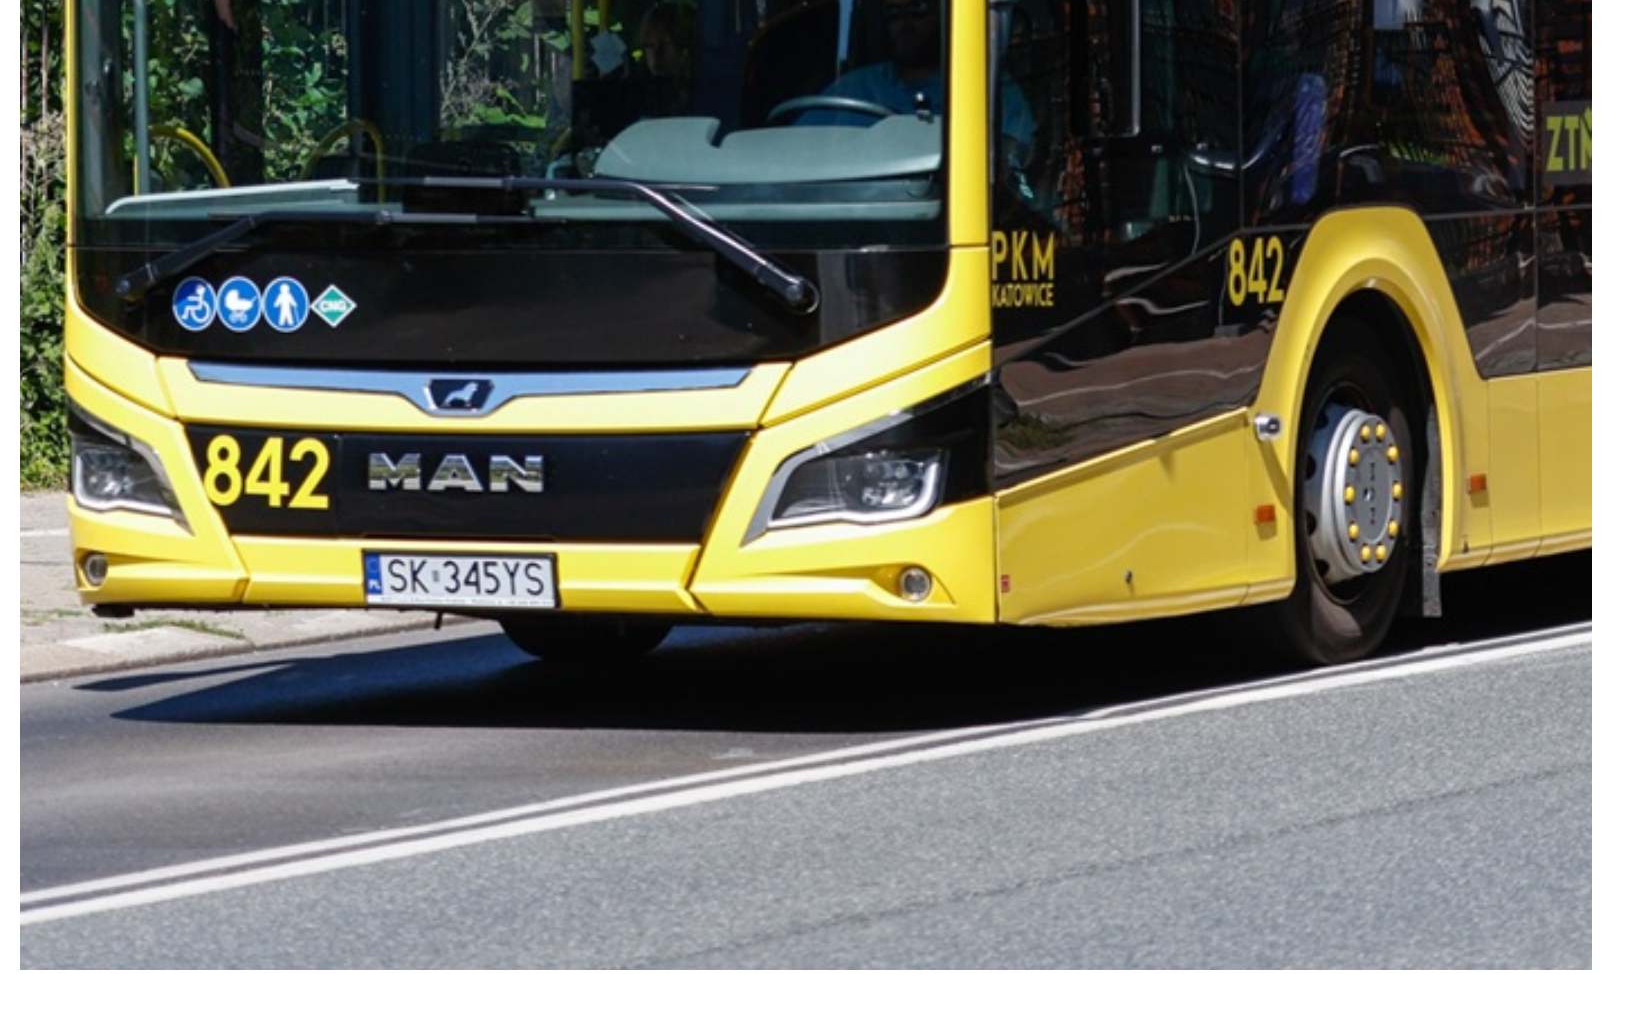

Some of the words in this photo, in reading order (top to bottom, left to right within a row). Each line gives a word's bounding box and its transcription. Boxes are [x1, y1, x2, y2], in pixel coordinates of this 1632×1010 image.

[992, 231, 1055, 281] PKM
[1229, 236, 1285, 306] 842
[992, 282, 1055, 307] KATOWICE
[203, 434, 330, 510] 842
[369, 453, 543, 492] MAN
[387, 559, 430, 594] SK
[442, 560, 545, 596] 345YS
